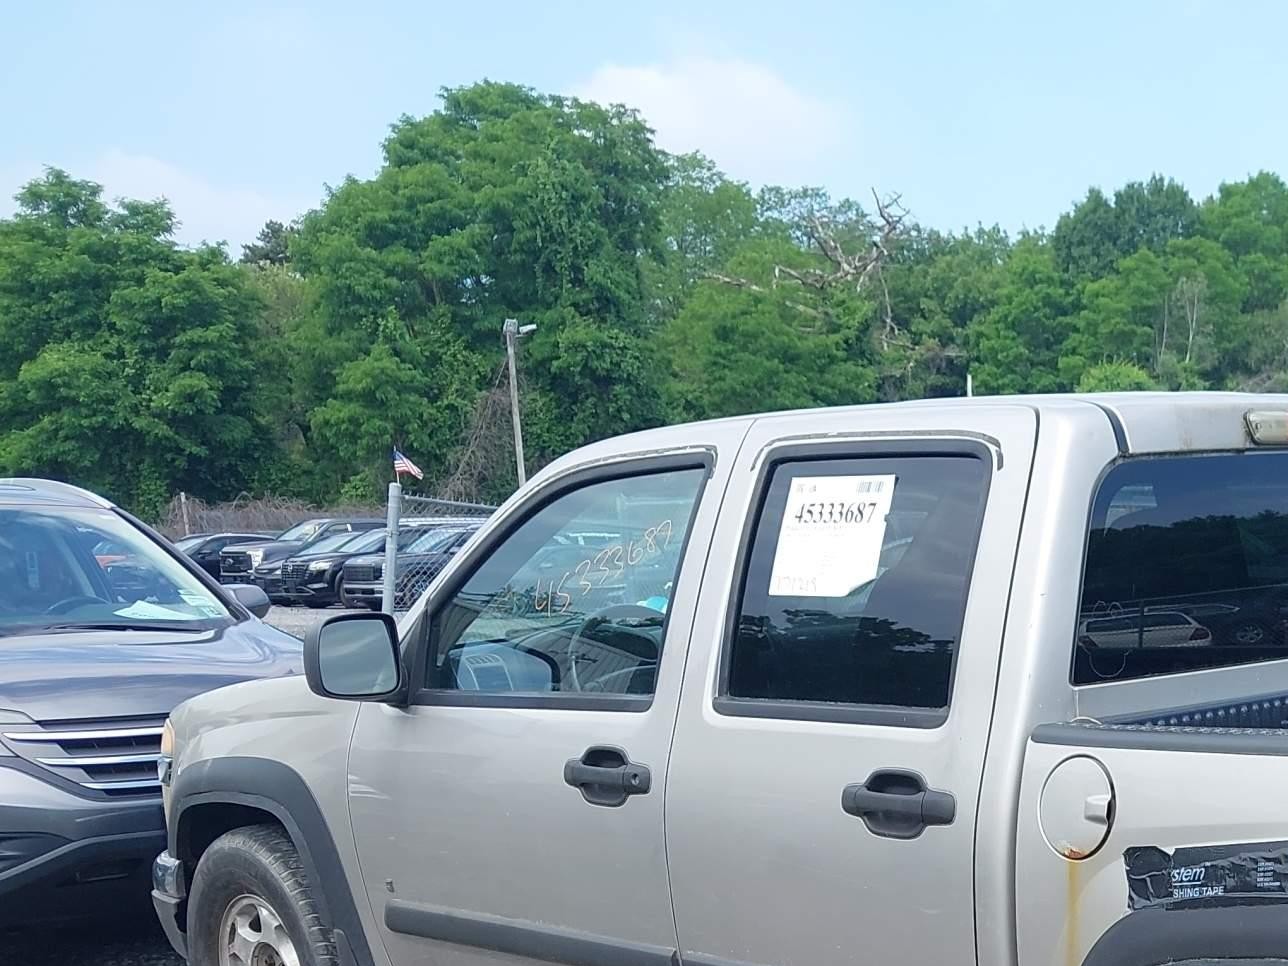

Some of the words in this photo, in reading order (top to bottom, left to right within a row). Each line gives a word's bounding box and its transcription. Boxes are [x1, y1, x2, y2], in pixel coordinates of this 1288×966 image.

[795, 502, 877, 524] 45333687
[1171, 866, 1206, 881] stem
[1201, 886, 1225, 897] TAPE
